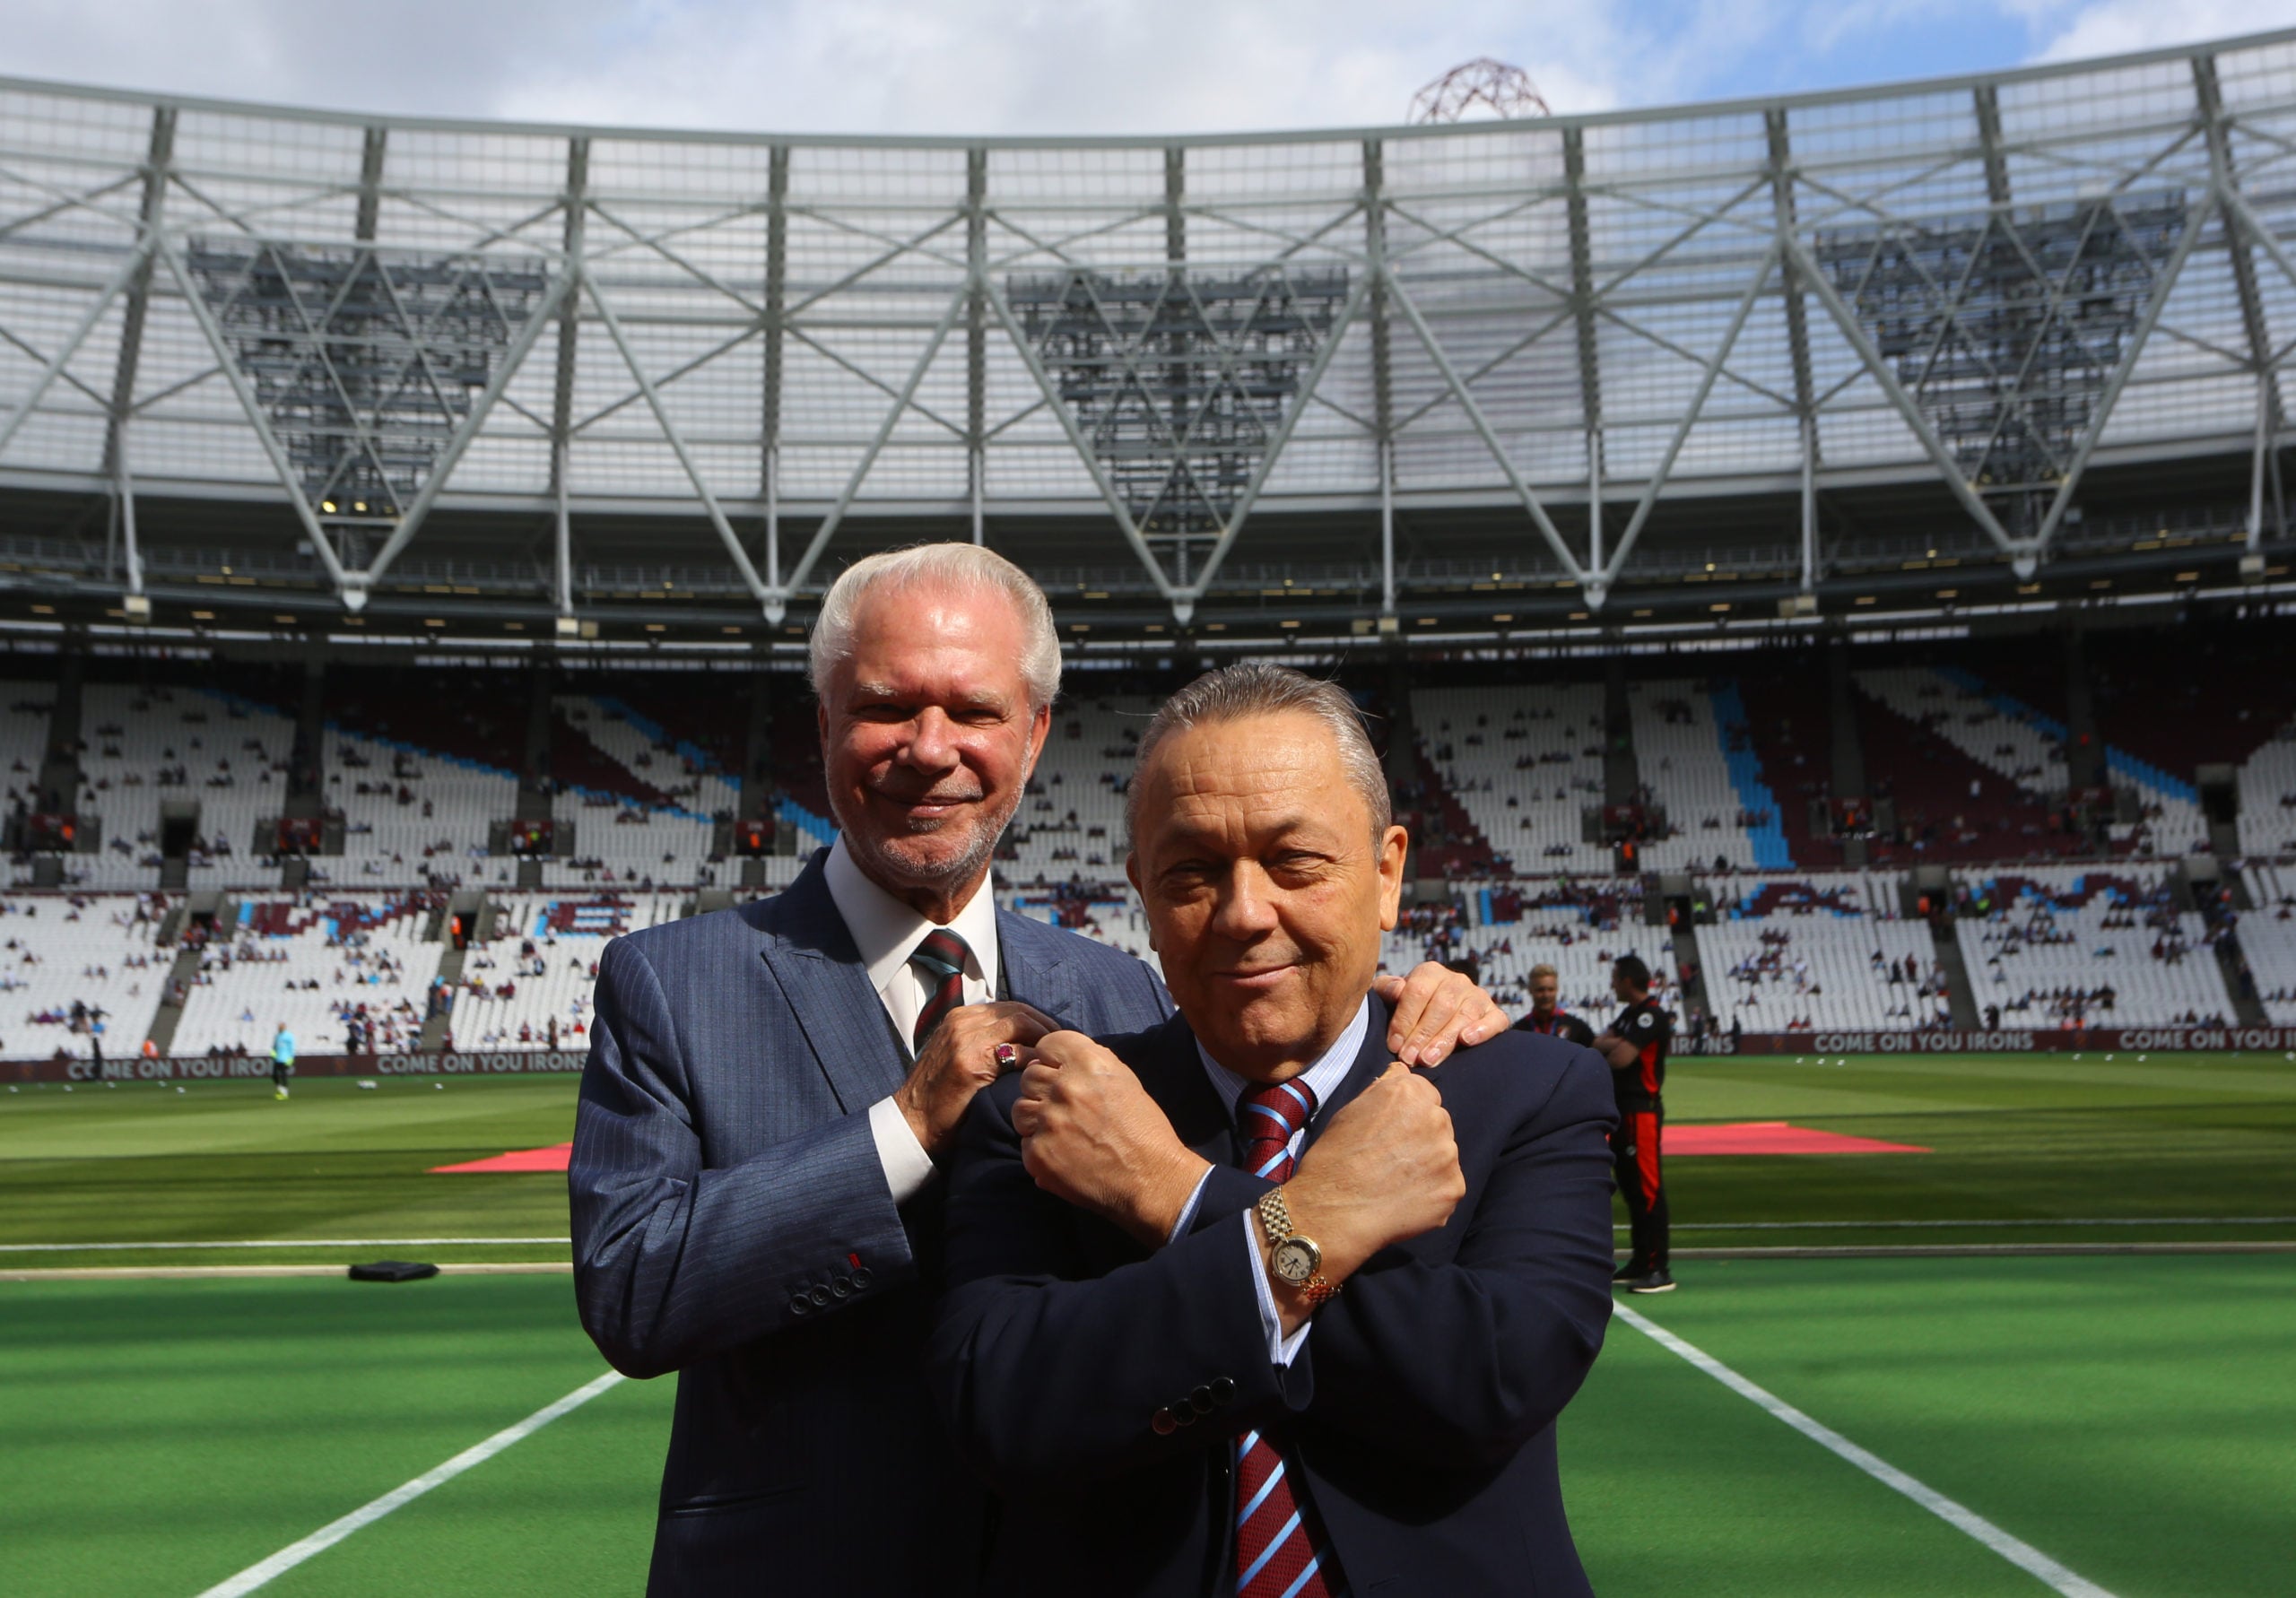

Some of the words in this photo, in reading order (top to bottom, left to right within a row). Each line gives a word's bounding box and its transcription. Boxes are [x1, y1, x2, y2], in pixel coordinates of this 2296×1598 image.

[1814, 1034, 1875, 1052] COME
[1880, 1033, 1911, 1050] ON
[1917, 1032, 1961, 1050] YOU
[1967, 1031, 2034, 1050] IRONS
[2119, 1030, 2185, 1049] COME
[2190, 1030, 2225, 1049] ON
[2230, 1029, 2280, 1048] YOU
[138, 1059, 172, 1078] ON
[177, 1058, 224, 1077] YOU
[377, 1054, 439, 1073] COME
[443, 1054, 474, 1072] ON
[478, 1053, 523, 1071] YOU
